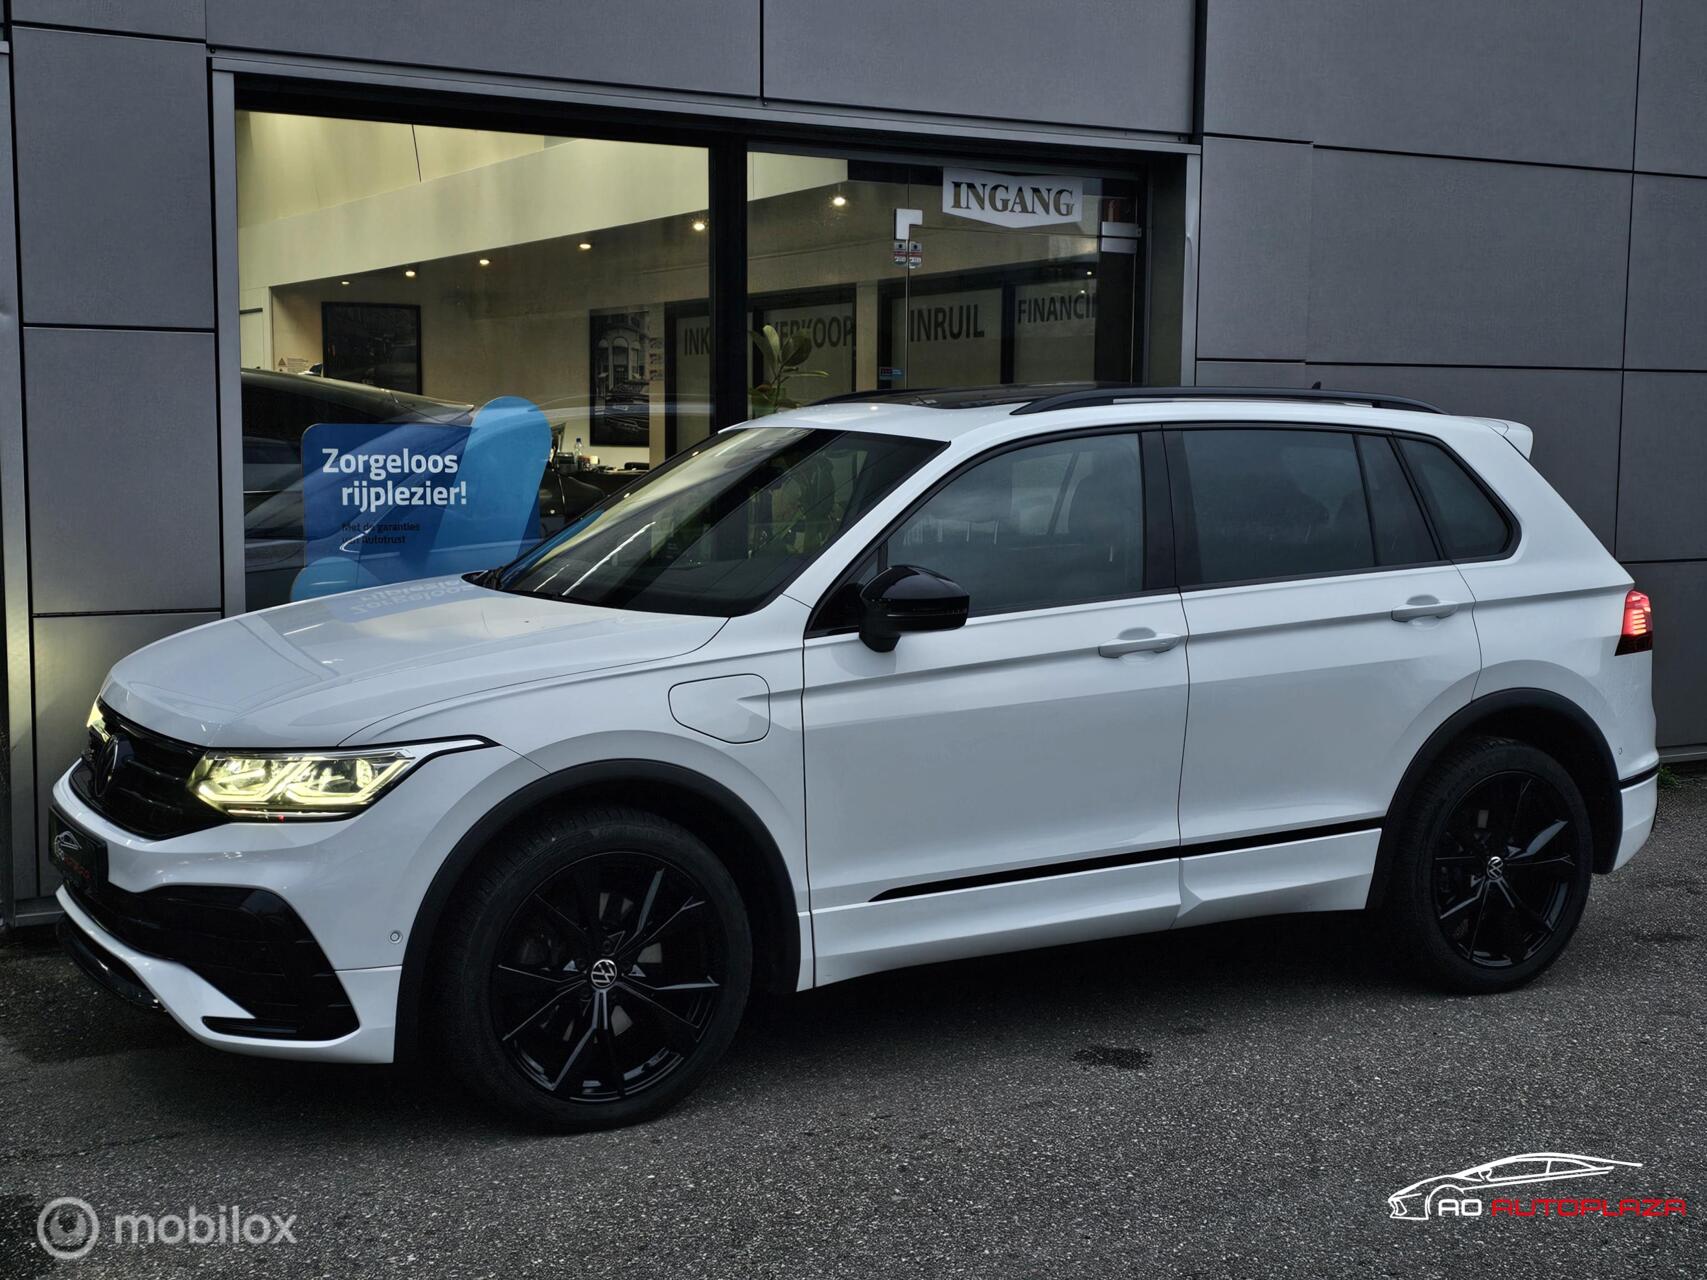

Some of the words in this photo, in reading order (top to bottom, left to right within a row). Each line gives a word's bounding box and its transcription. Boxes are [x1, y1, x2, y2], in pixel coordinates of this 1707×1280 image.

[951, 180, 1075, 217] INGANG
[767, 315, 853, 349] EROOP
[909, 303, 985, 342] INRUIL
[321, 447, 459, 481] Zorgeloos
[341, 480, 467, 513] rijplezier!
